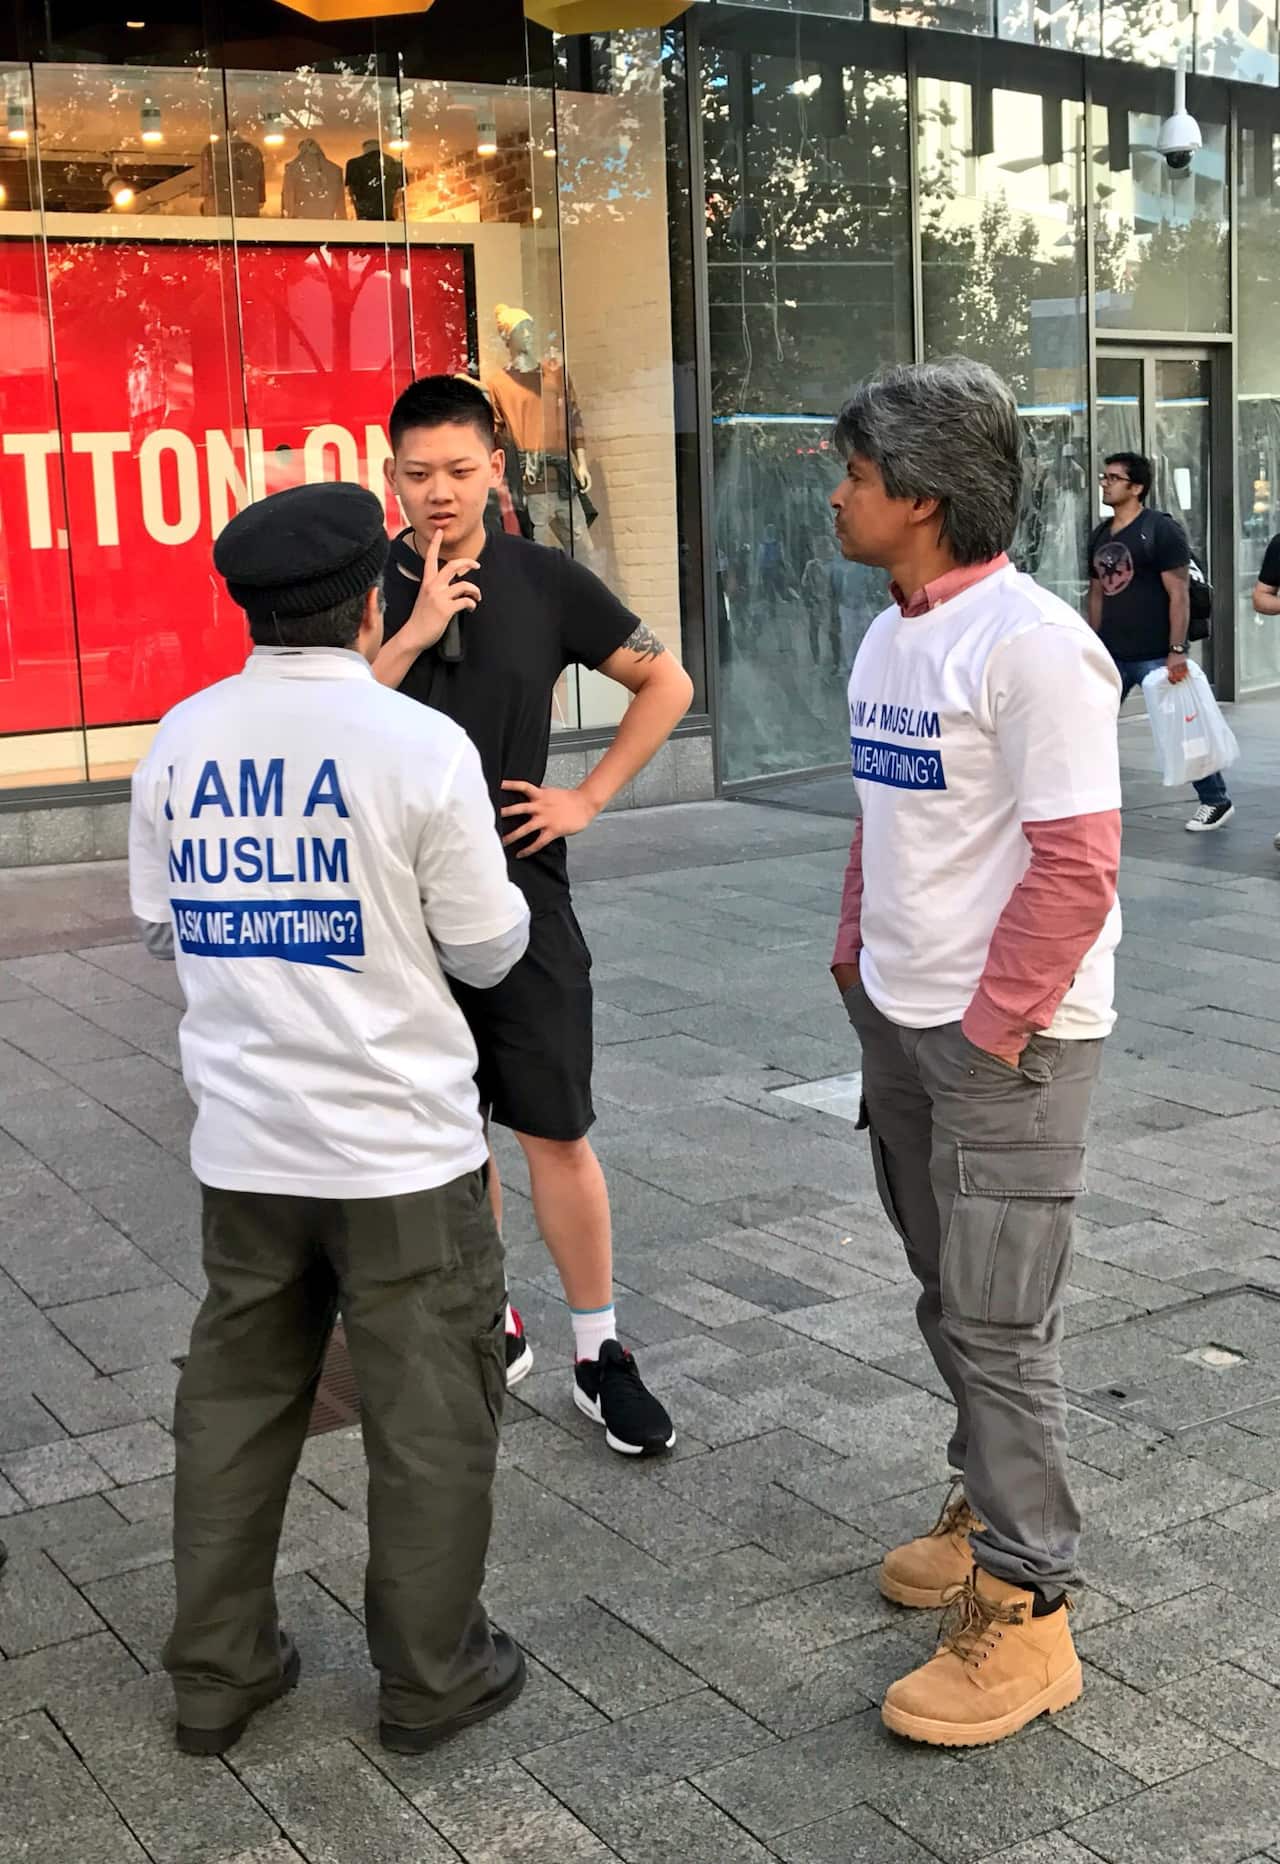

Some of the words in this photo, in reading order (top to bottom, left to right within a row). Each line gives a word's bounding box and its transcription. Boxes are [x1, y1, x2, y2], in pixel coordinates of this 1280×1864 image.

[880, 704, 941, 737] MUSLIM
[871, 748, 938, 783] ANYTHING?
[190, 758, 285, 819] AM
[303, 758, 350, 819] A
[169, 836, 350, 884] MUSLIM
[178, 909, 206, 944] ASK
[206, 911, 236, 945] ME
[239, 909, 358, 945] ANYTHING?
